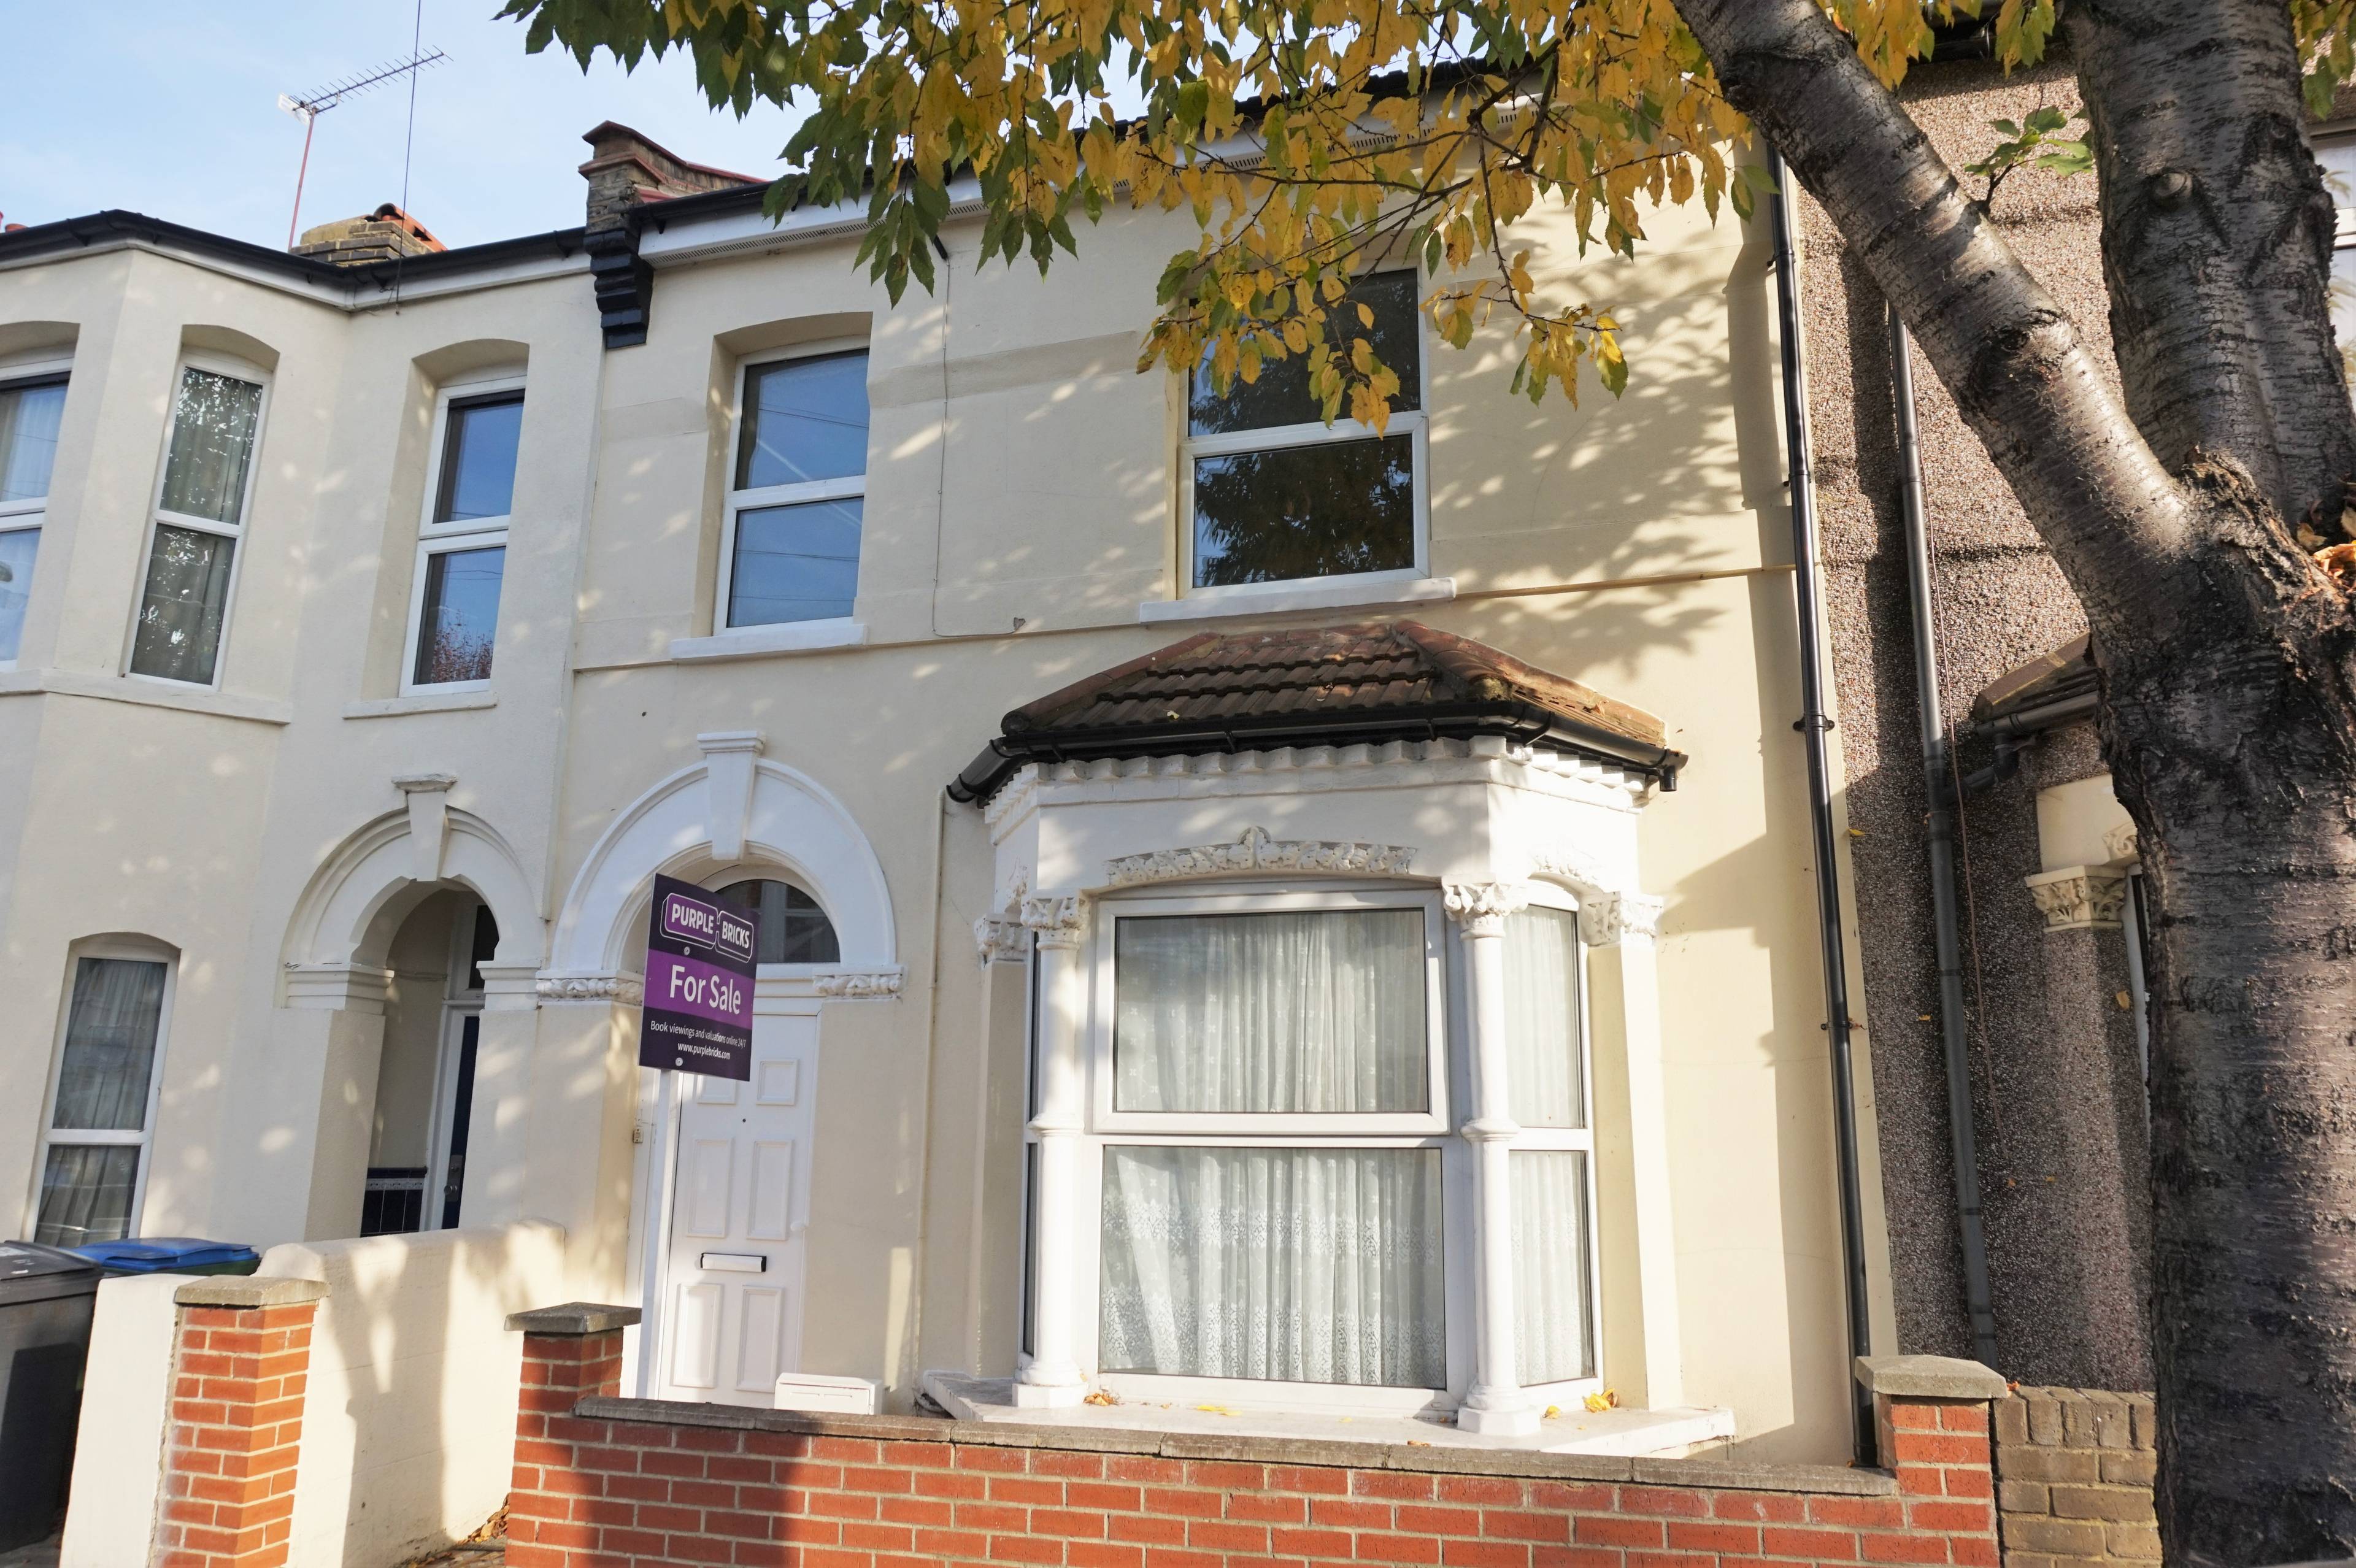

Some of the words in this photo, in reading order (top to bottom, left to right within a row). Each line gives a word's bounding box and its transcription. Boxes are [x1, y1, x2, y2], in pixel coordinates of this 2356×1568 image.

[671, 904, 714, 934] PURPLE
[722, 923, 750, 948] BRICKS
[669, 964, 706, 1004] For
[709, 975, 741, 1015] Sale
[650, 1020, 668, 1032] Book
[669, 1023, 695, 1039] viewings
[695, 1028, 705, 1039] and
[705, 1030, 726, 1044] valuations
[726, 1036, 738, 1047] online
[737, 1038, 747, 1049] 24/7
[677, 1042, 731, 1060] www.purplebricks.com
